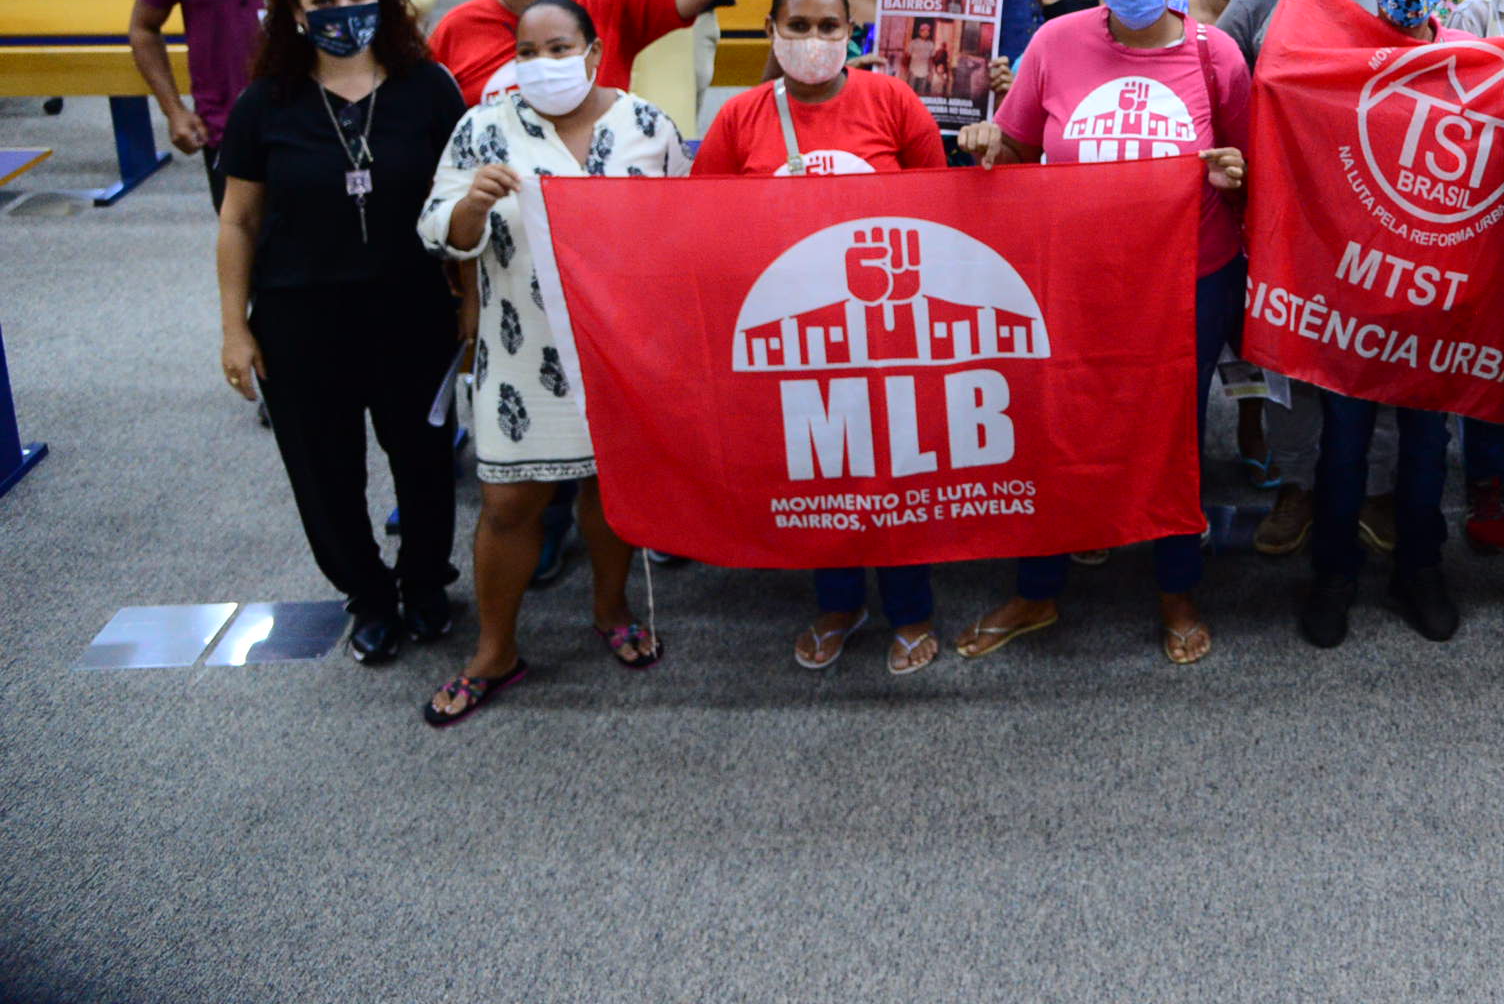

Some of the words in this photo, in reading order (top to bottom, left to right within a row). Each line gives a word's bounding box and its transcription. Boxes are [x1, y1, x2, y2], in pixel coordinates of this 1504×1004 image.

[1338, 145, 1354, 171] NA
[1346, 170, 1376, 211] LUTA
[1372, 204, 1408, 239] PELA
[1410, 227, 1475, 247] REFORMA
[1397, 169, 1473, 210] BRASIL
[1335, 241, 1469, 311] MTST
[780, 369, 1016, 481] MLB
[771, 493, 899, 513] MOVIMENTO
[906, 489, 930, 506] DE
[938, 482, 987, 501] LUTA
[993, 479, 1037, 497] NOS
[776, 511, 867, 532] BAIRROS,
[871, 507, 928, 528] VILAS
[935, 505, 944, 520] E
[951, 499, 1036, 518] FAVELAS
